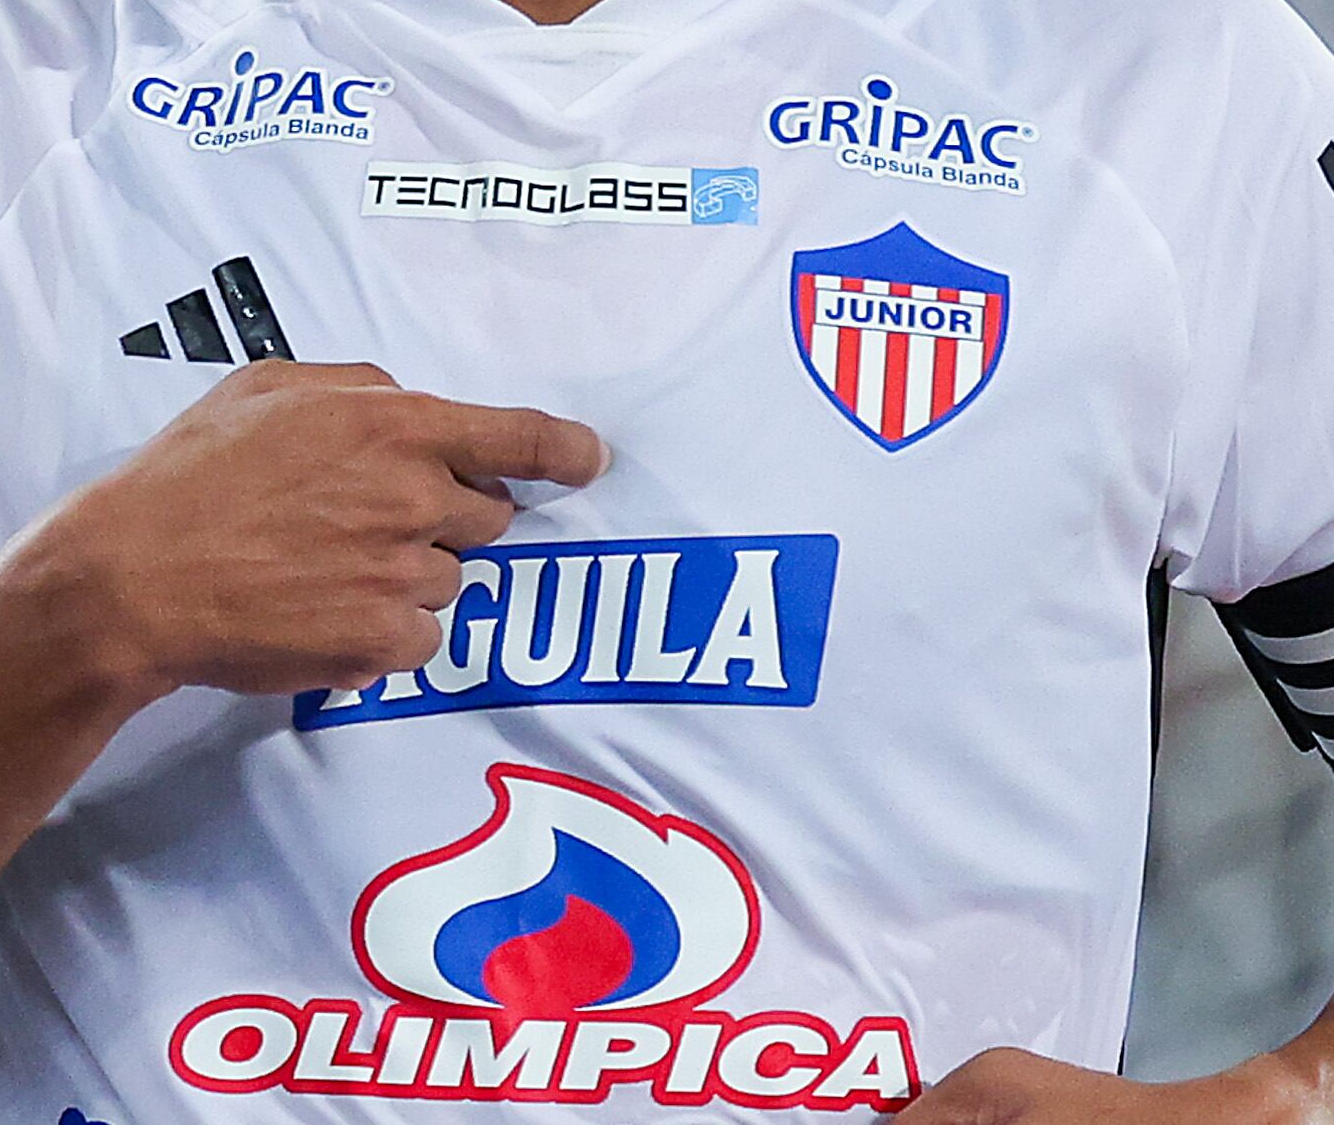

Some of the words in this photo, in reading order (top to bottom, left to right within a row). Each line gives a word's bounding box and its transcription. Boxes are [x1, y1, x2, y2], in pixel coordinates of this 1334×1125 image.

[194, 125, 280, 148] Cápsula
[288, 118, 369, 140] Blanda
[841, 147, 933, 178] Cápsula
[942, 166, 1019, 190] Blanda
[368, 175, 687, 213] TECNOGLASS
[824, 296, 973, 335] JUNIOR
[320, 549, 789, 711] GUILA
[181, 1007, 911, 1100] OLIMPICA
